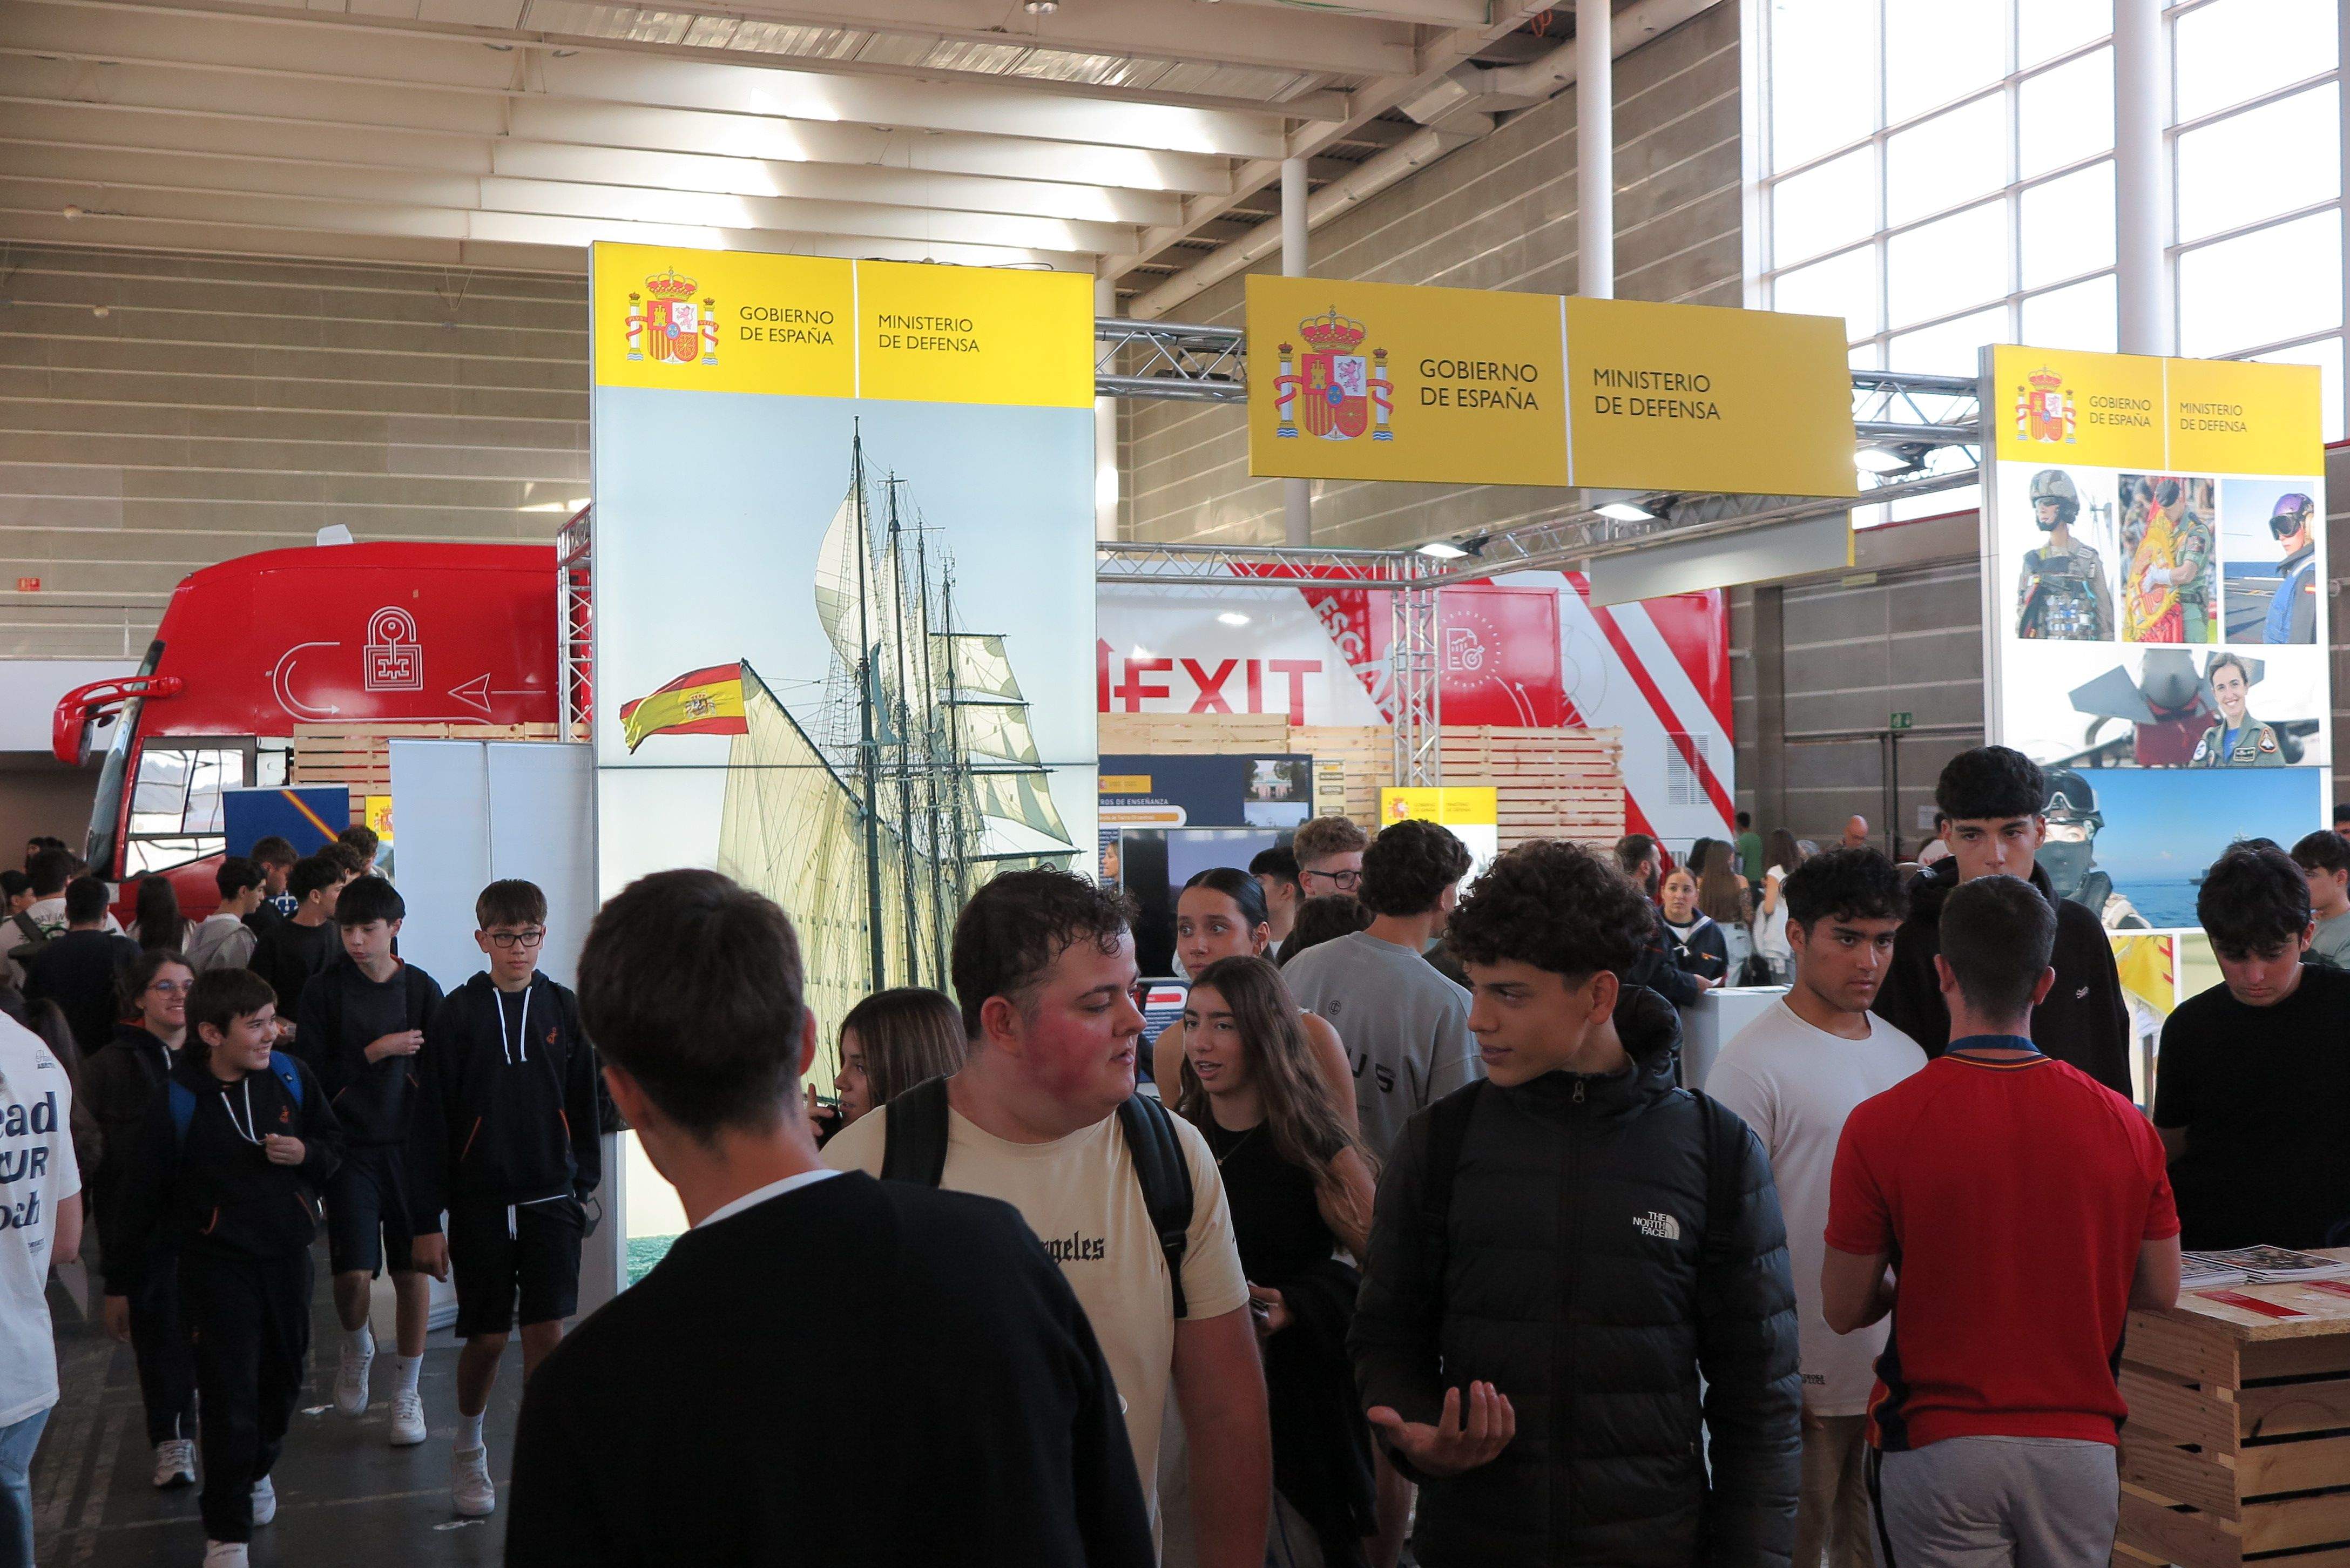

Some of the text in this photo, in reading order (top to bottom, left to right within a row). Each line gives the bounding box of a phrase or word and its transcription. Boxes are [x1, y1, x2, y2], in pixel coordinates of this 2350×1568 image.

[740, 306, 834, 325] GOBIERNO
[879, 314, 973, 333] MINISTERIO
[740, 326, 834, 345] DE ESPAÑA
[879, 334, 980, 353] DE DEFENSA
[1420, 359, 1538, 383] GOBIERNO
[1593, 368, 1711, 393] MINISTERIO
[1421, 386, 1539, 410] DE ESPAÑA
[1595, 395, 1721, 420] DE DEFENSA
[2089, 395, 2151, 411] GOBIERNO
[2180, 402, 2242, 416] MINISTERIO
[2090, 412, 2151, 427] DE ESPAÑA
[2180, 418, 2247, 432] DE DEFENSA
[1632, 1216, 1666, 1229] NORTH
[1647, 1211, 1667, 1221] THE
[1641, 1226, 1666, 1238] FACE
